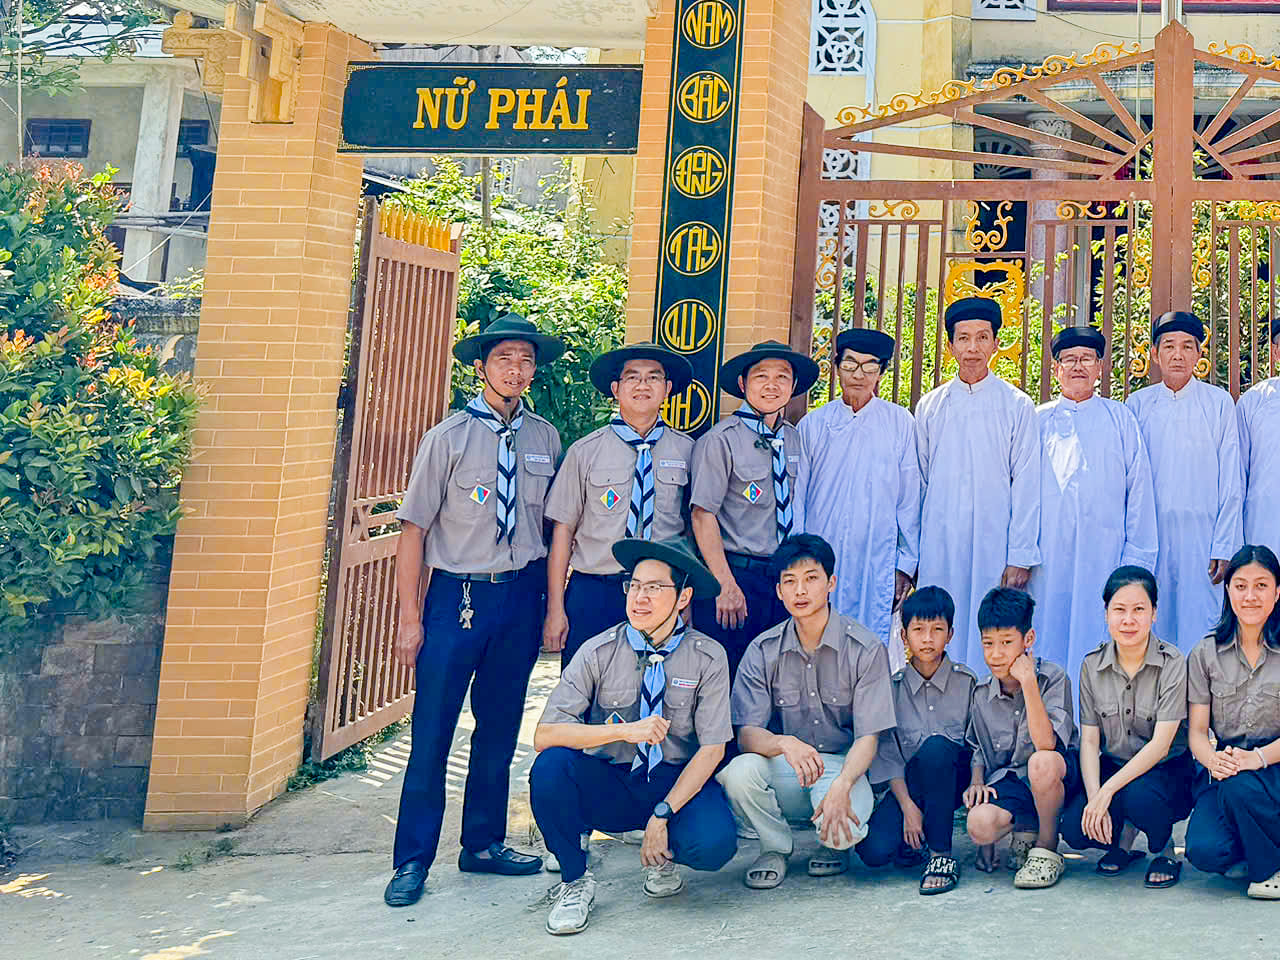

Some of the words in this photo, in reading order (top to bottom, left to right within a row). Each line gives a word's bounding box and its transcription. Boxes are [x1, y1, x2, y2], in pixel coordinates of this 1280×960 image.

[686, 1, 733, 44] NAM
[413, 75, 477, 130] NỮ
[485, 75, 592, 131] PHÁI
[681, 74, 728, 119] BẮC
[670, 225, 717, 271] TÂY
